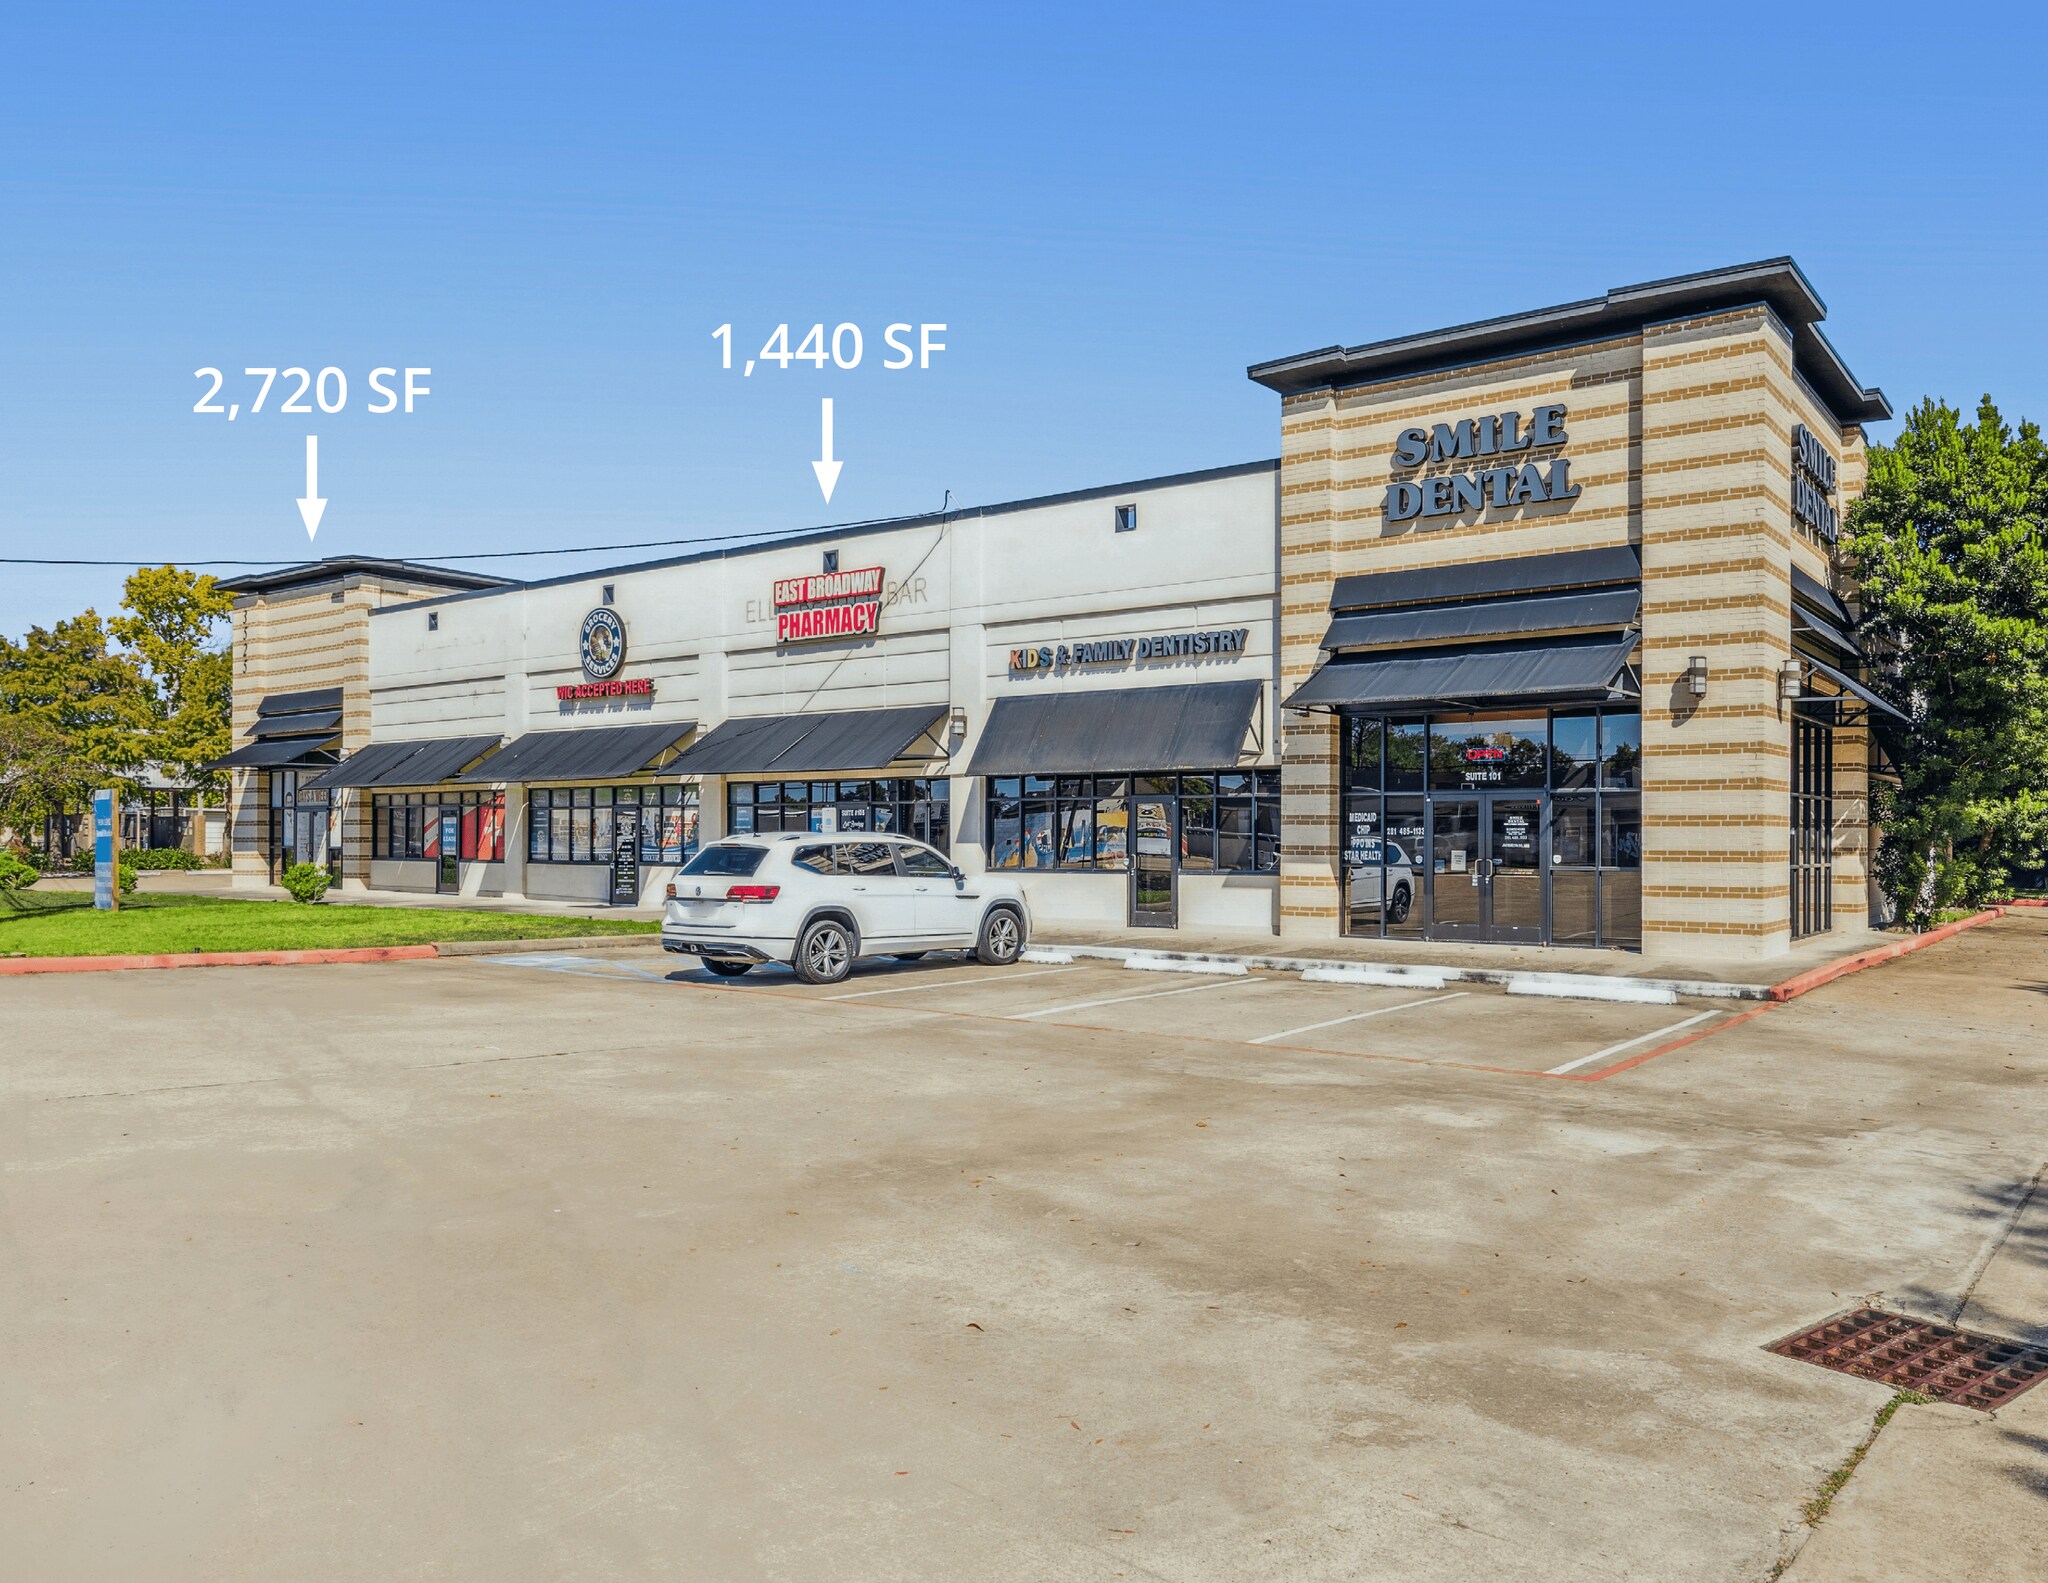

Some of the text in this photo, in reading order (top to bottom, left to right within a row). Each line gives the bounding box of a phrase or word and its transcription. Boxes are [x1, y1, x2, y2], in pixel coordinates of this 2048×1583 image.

[1396, 404, 1569, 467] SMILE
[1796, 423, 1836, 494] SMILE
[1386, 459, 1583, 522] DENTAL
[1794, 471, 1838, 544] DENTAL
[775, 577, 806, 604] EAST
[807, 568, 881, 600] BROADWAY
[887, 577, 928, 606] BAR
[585, 612, 617, 633] GROCERY
[778, 602, 878, 640] PHARMACY
[1010, 628, 1249, 669] KIDS & FAMILY DENTISTRY
[586, 653, 618, 675] SERVICES
[556, 678, 653, 700] WIC ACCEPTED HERE
[1467, 749, 1503, 761] OPEN
[1465, 772, 1501, 781] SUITE 101
[841, 809, 854, 817] SUITE
[1349, 812, 1377, 823] MEDICAID
[1356, 825, 1371, 835] CHIP
[1387, 827, 1397, 835] 281
[1344, 851, 1360, 861] STAR
